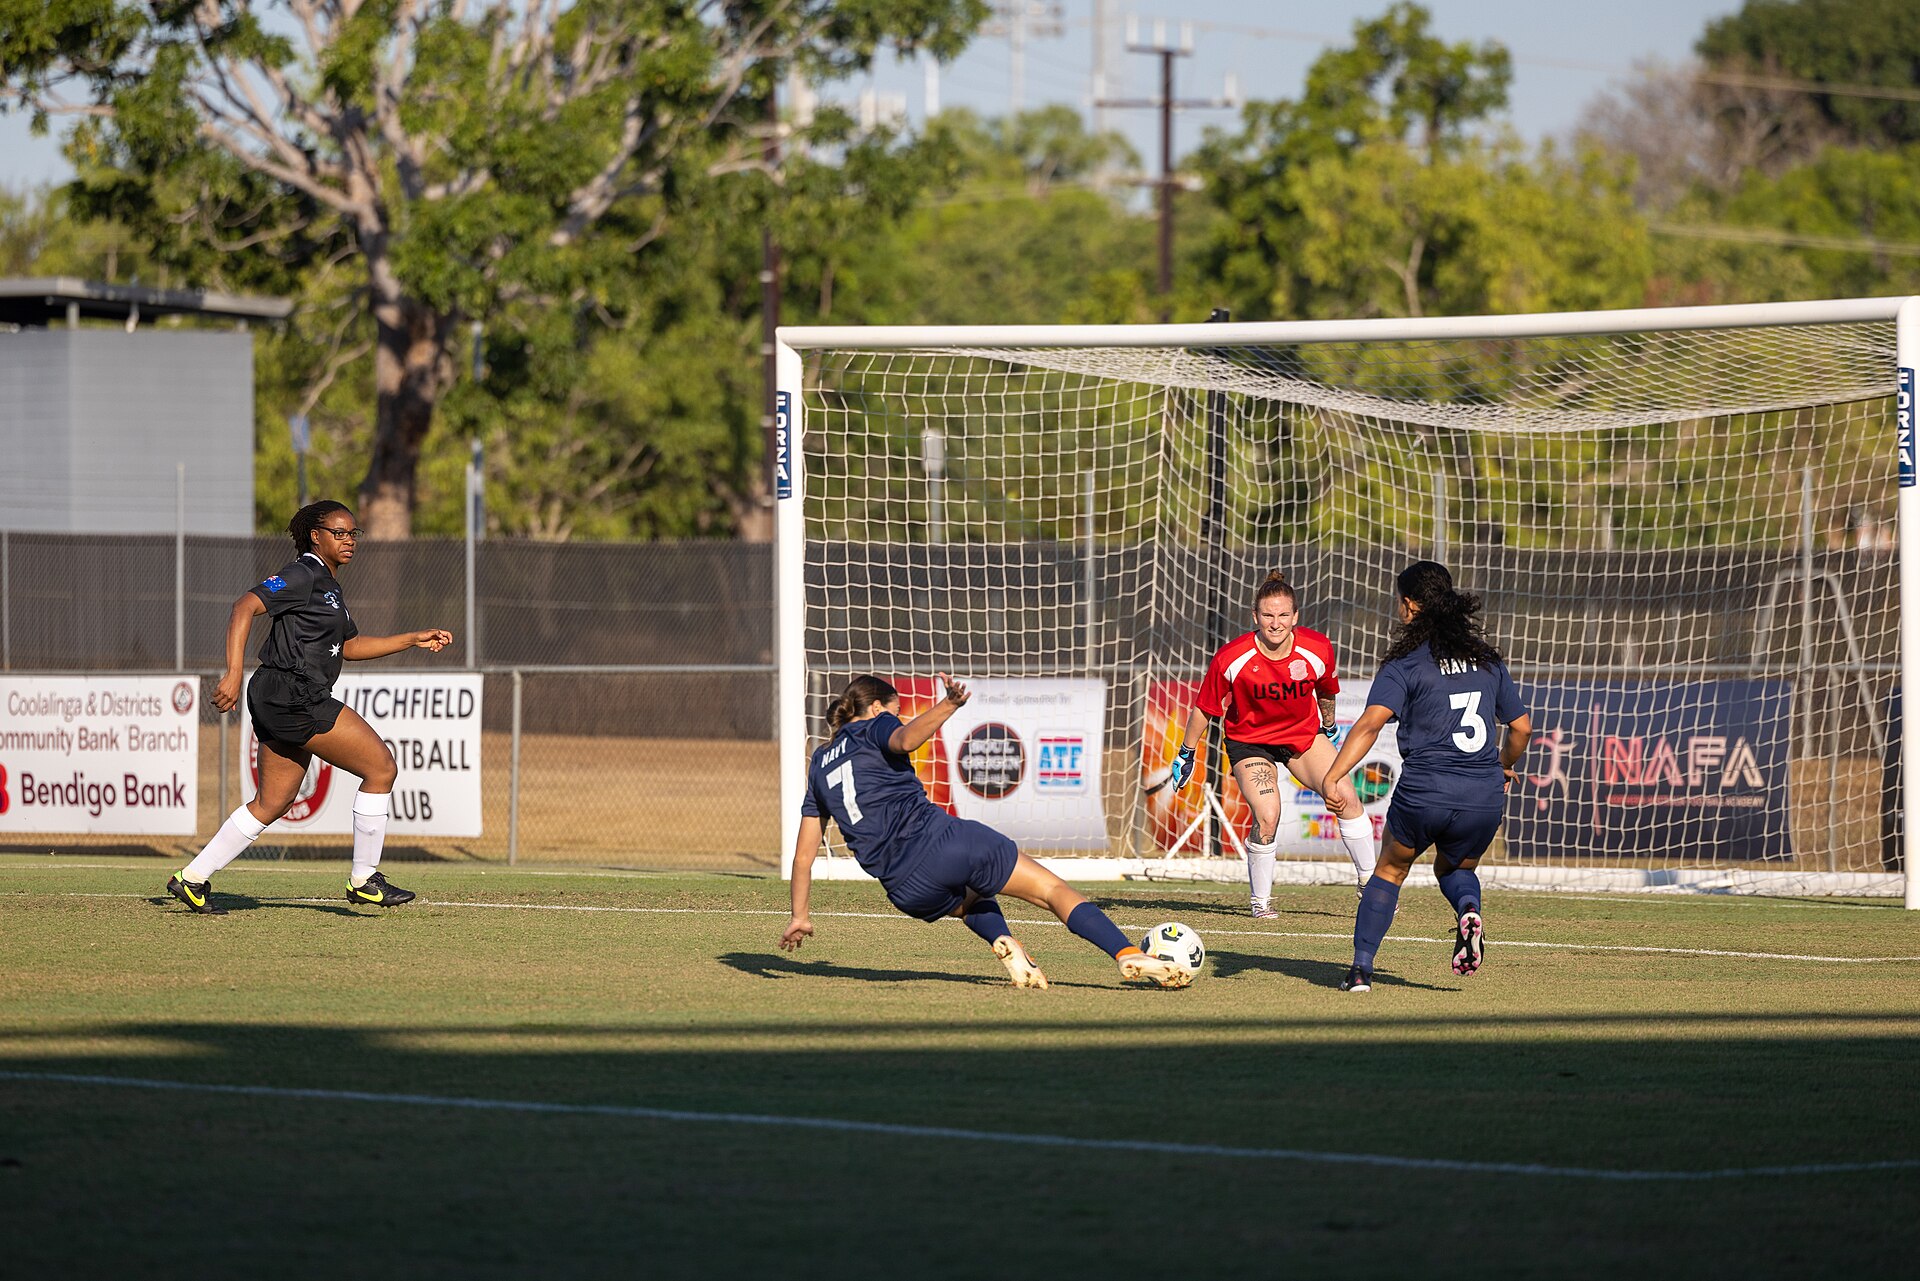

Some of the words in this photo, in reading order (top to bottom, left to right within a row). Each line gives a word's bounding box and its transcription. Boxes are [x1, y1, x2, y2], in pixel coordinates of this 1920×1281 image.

[1897, 371, 1912, 466] FORZA
[776, 394, 788, 480] FORZA
[1440, 658, 1477, 676] NAVY
[8, 690, 82, 722] Coolalinga
[85, 692, 97, 717] &
[100, 691, 162, 717] Districts
[1253, 680, 1310, 700] USMC
[1449, 691, 1487, 753] 3
[0, 726, 74, 757] ommunity
[78, 725, 119, 751] Bank
[128, 724, 188, 752] Branch
[821, 737, 847, 768] NAVY
[1039, 745, 1082, 769] ATF
[1604, 736, 1765, 787] NAFA
[21, 772, 116, 817] Bendigo
[124, 772, 186, 808] Bank
[389, 790, 433, 821] LUB
[826, 759, 864, 826] 7
